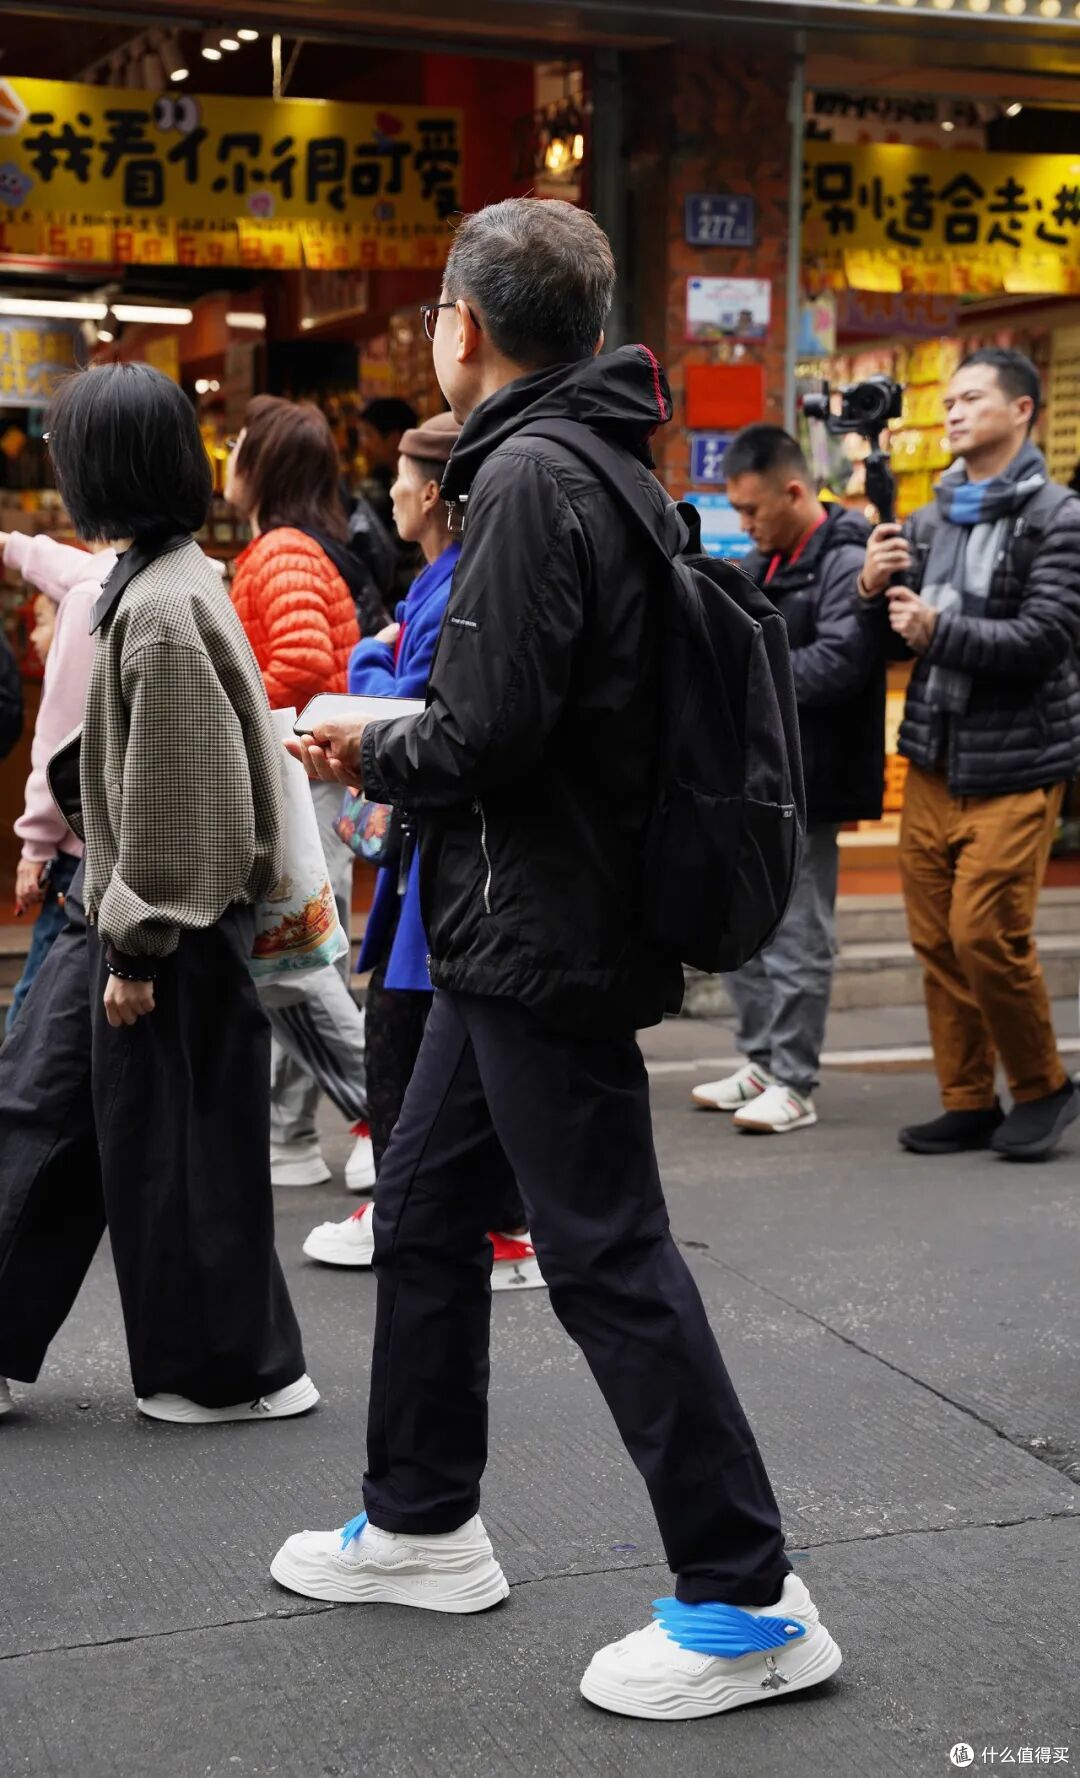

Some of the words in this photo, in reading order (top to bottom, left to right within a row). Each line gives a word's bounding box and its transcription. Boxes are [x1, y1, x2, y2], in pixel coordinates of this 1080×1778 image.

[22, 109, 464, 219] 我看你很可爱
[803, 160, 1080, 249] 别适合走进
[698, 214, 736, 240] 277
